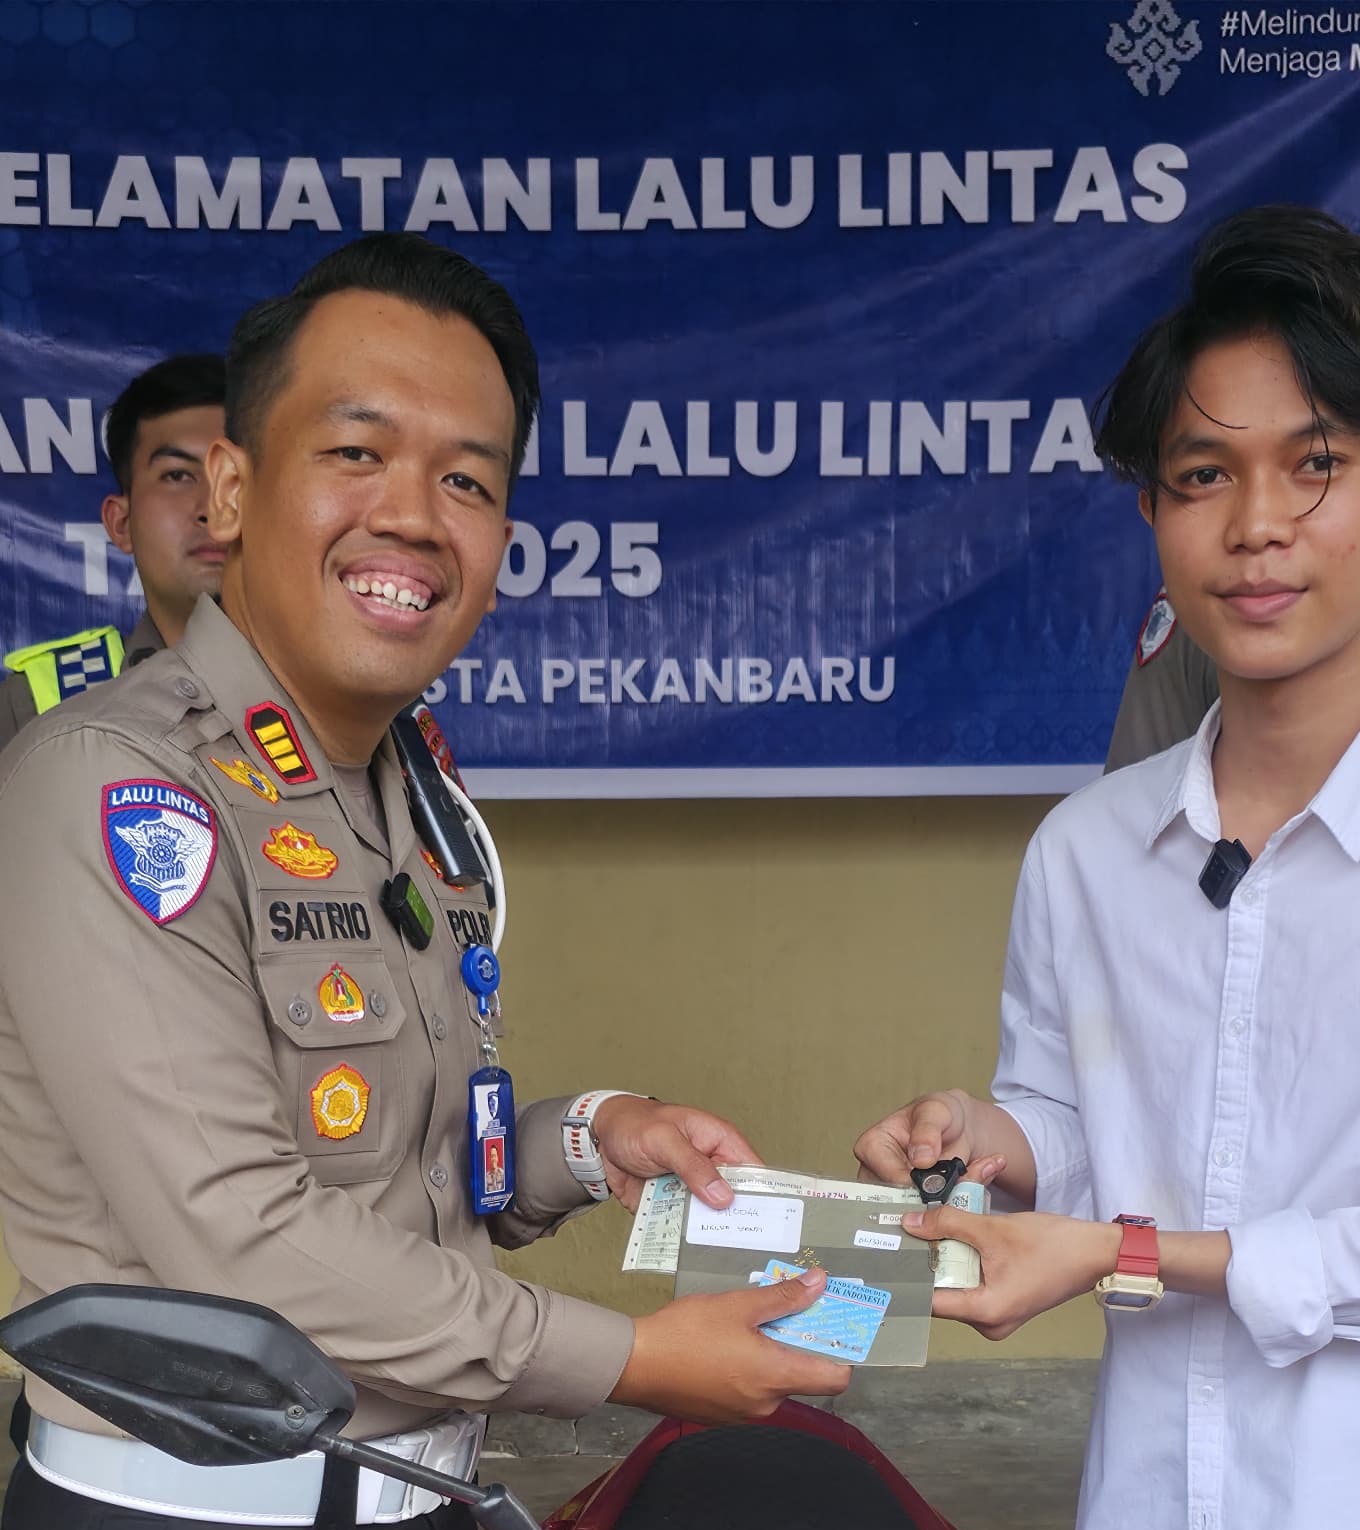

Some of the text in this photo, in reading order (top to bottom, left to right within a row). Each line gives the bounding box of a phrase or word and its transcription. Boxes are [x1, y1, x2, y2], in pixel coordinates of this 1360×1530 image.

[1219, 47, 1341, 79] Menjaga
[575, 155, 814, 232] LALU
[839, 143, 1189, 227] LINTAS
[563, 400, 797, 478] LALU
[820, 398, 1104, 475] LINTA
[496, 521, 663, 598] 025
[542, 656, 895, 704] PEKANBARU
[111, 787, 209, 823] LALU LINTAS
[269, 900, 371, 942] SATRIO
[842, 1289, 887, 1306] INDONESIA
